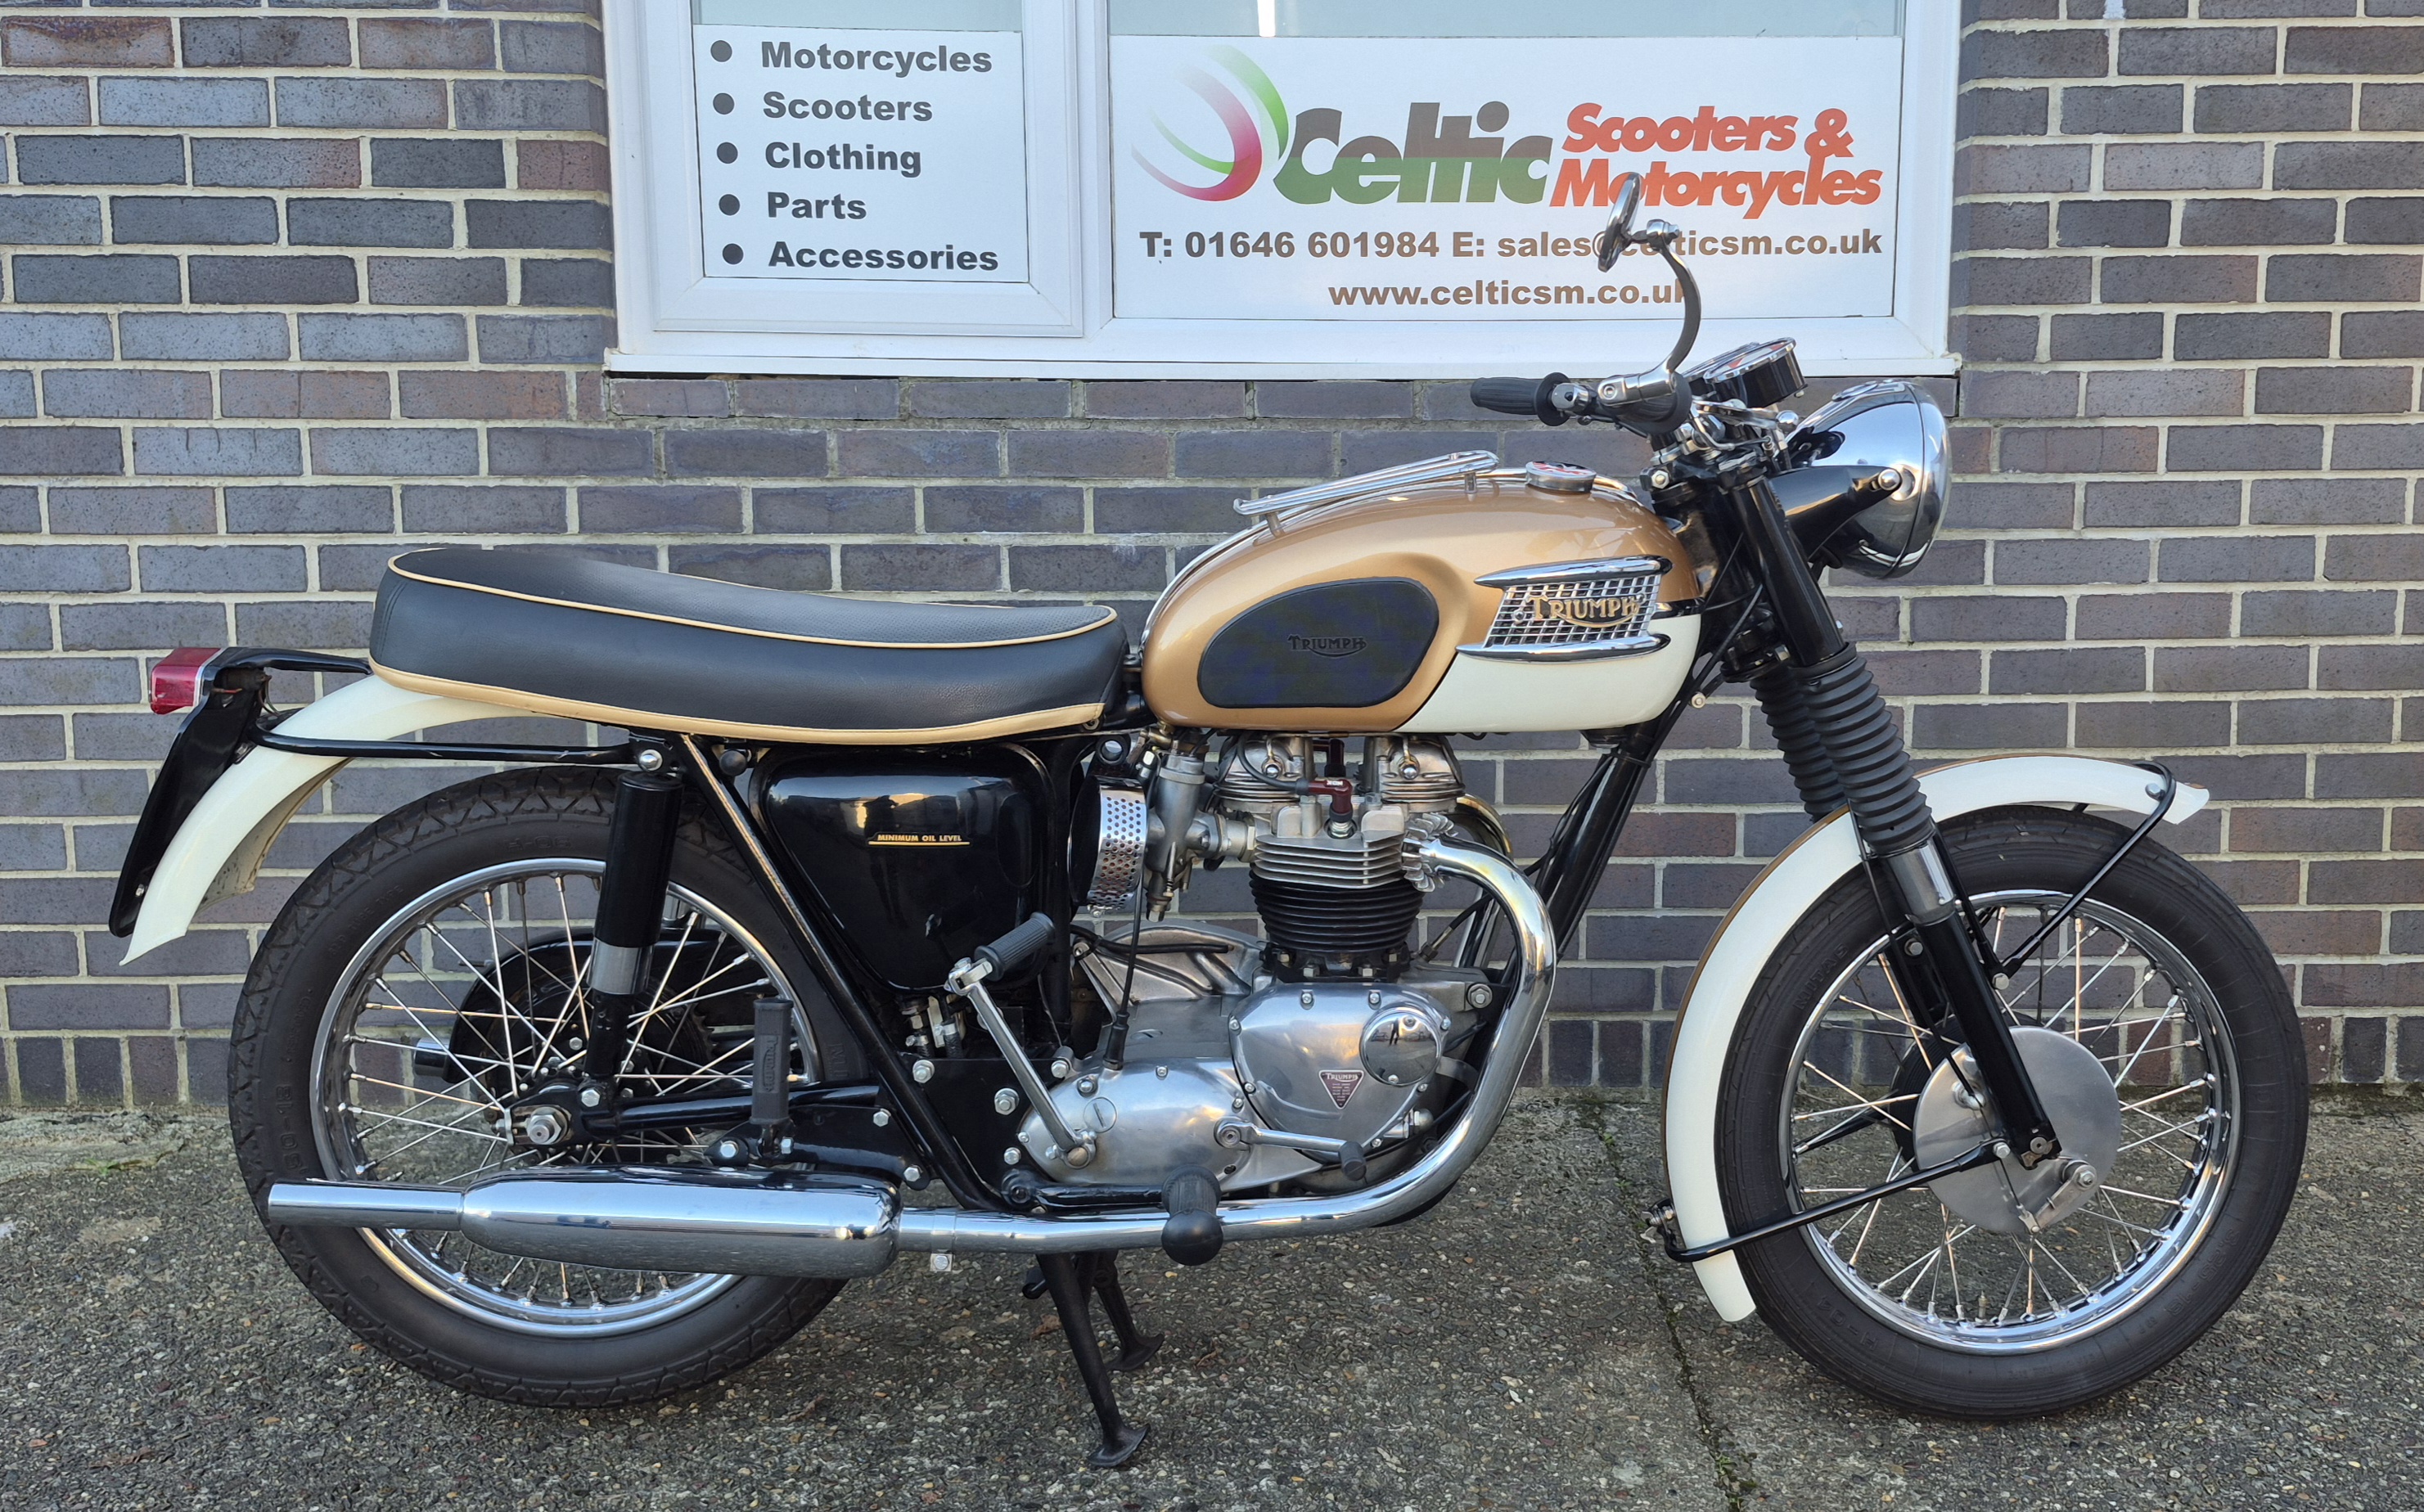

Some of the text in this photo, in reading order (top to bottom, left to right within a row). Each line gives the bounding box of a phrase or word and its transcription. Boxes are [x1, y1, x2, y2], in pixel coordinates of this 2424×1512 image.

[761, 41, 993, 79] Motorcycles
[763, 91, 933, 122] Scooters
[1563, 103, 1854, 159] Scooters &
[765, 142, 921, 178] Clothing
[1273, 101, 1553, 205] Celtic
[767, 191, 867, 220] Parts
[768, 241, 999, 272] Accessories
[1139, 228, 1882, 260] T: 01646 601984 E: salesticsm.co.uk
[1525, 595, 1642, 628] TRIUMPH
[1287, 634, 1367, 658] TRIUMPH
[876, 834, 919, 842] MINIMUM
[1325, 1072, 1358, 1082] TRIUMPH
[276, 1085, 309, 1176] .50-18
